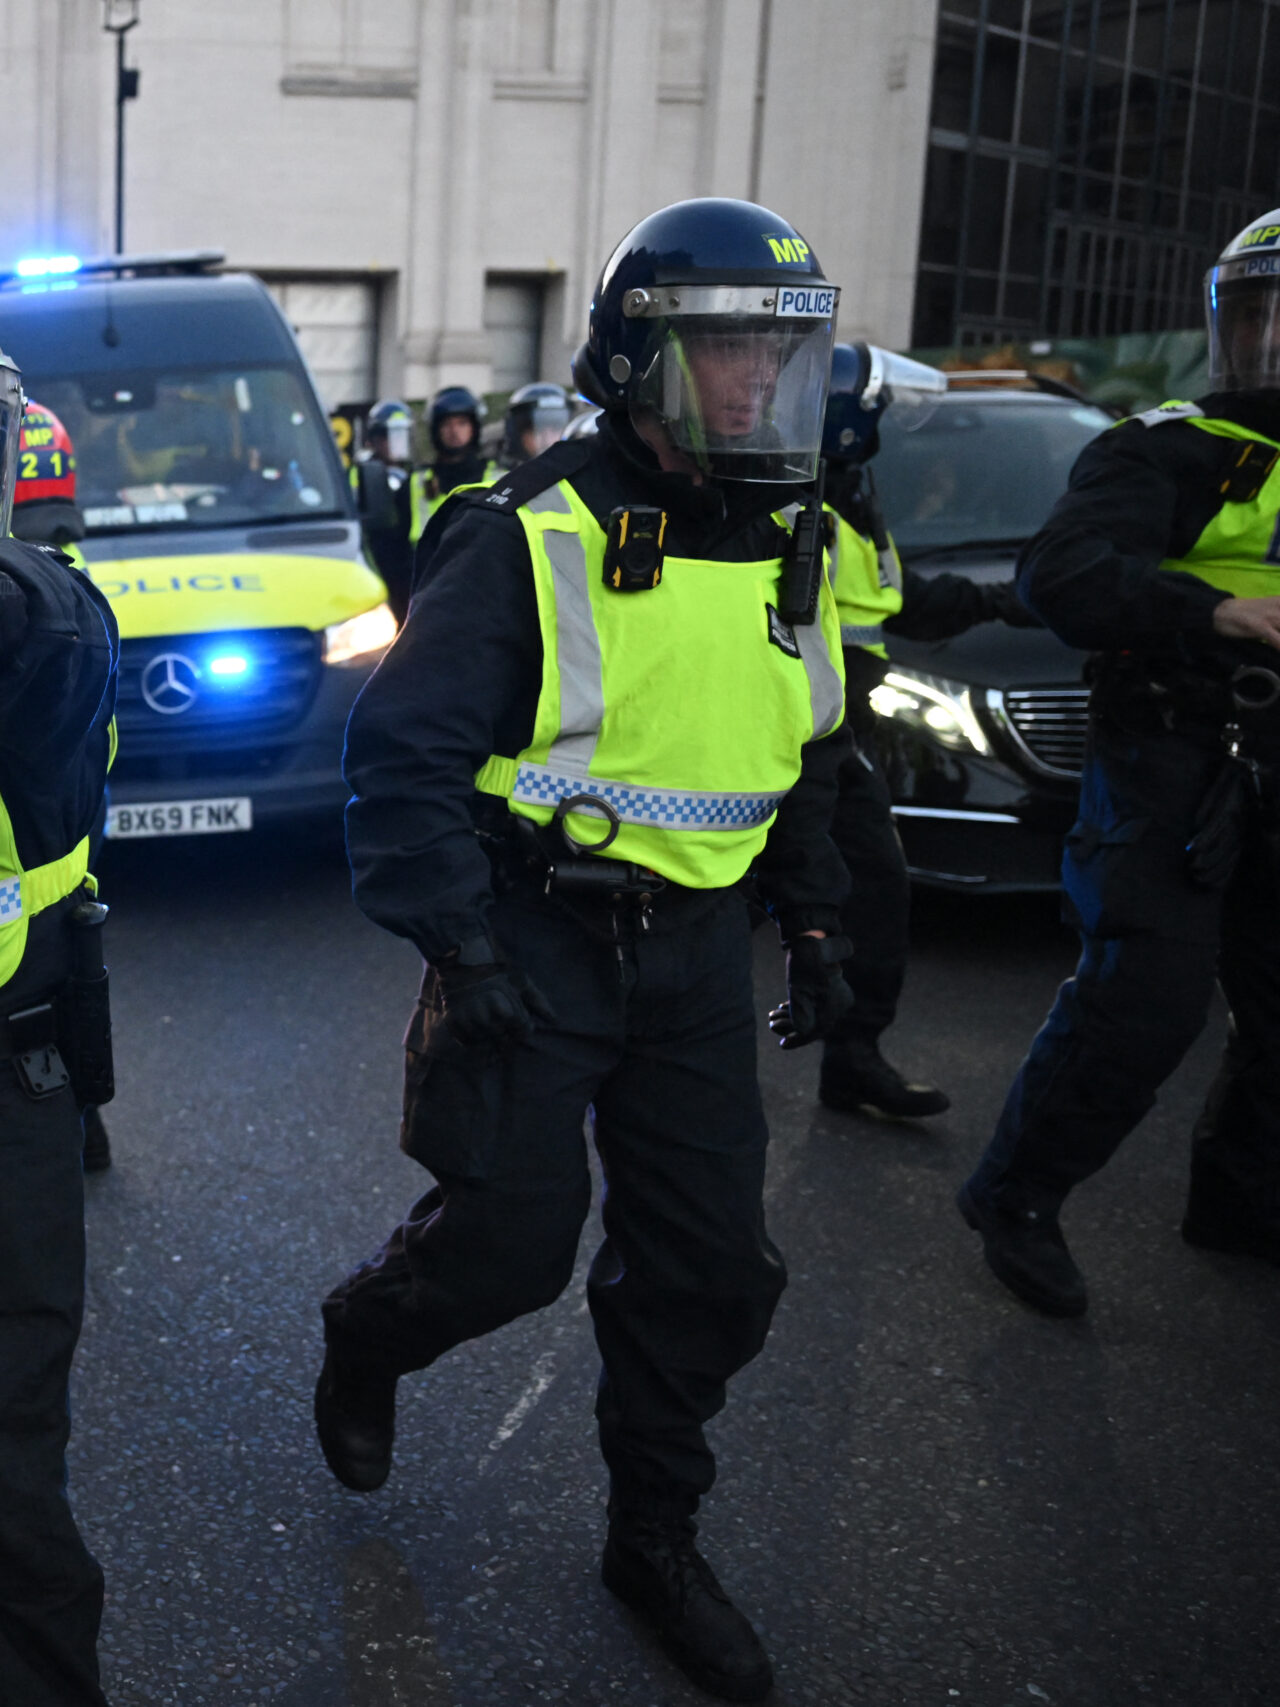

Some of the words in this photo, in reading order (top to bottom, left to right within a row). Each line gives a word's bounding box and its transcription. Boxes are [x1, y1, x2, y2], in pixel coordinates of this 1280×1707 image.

[1239, 226, 1280, 248] MP
[768, 238, 809, 263] MP
[1247, 257, 1280, 274] POL
[781, 291, 832, 313] POLICE
[24, 428, 53, 447] MP
[97, 575, 265, 599] OLICE
[117, 806, 183, 832] BX69
[191, 803, 240, 828] FNK
